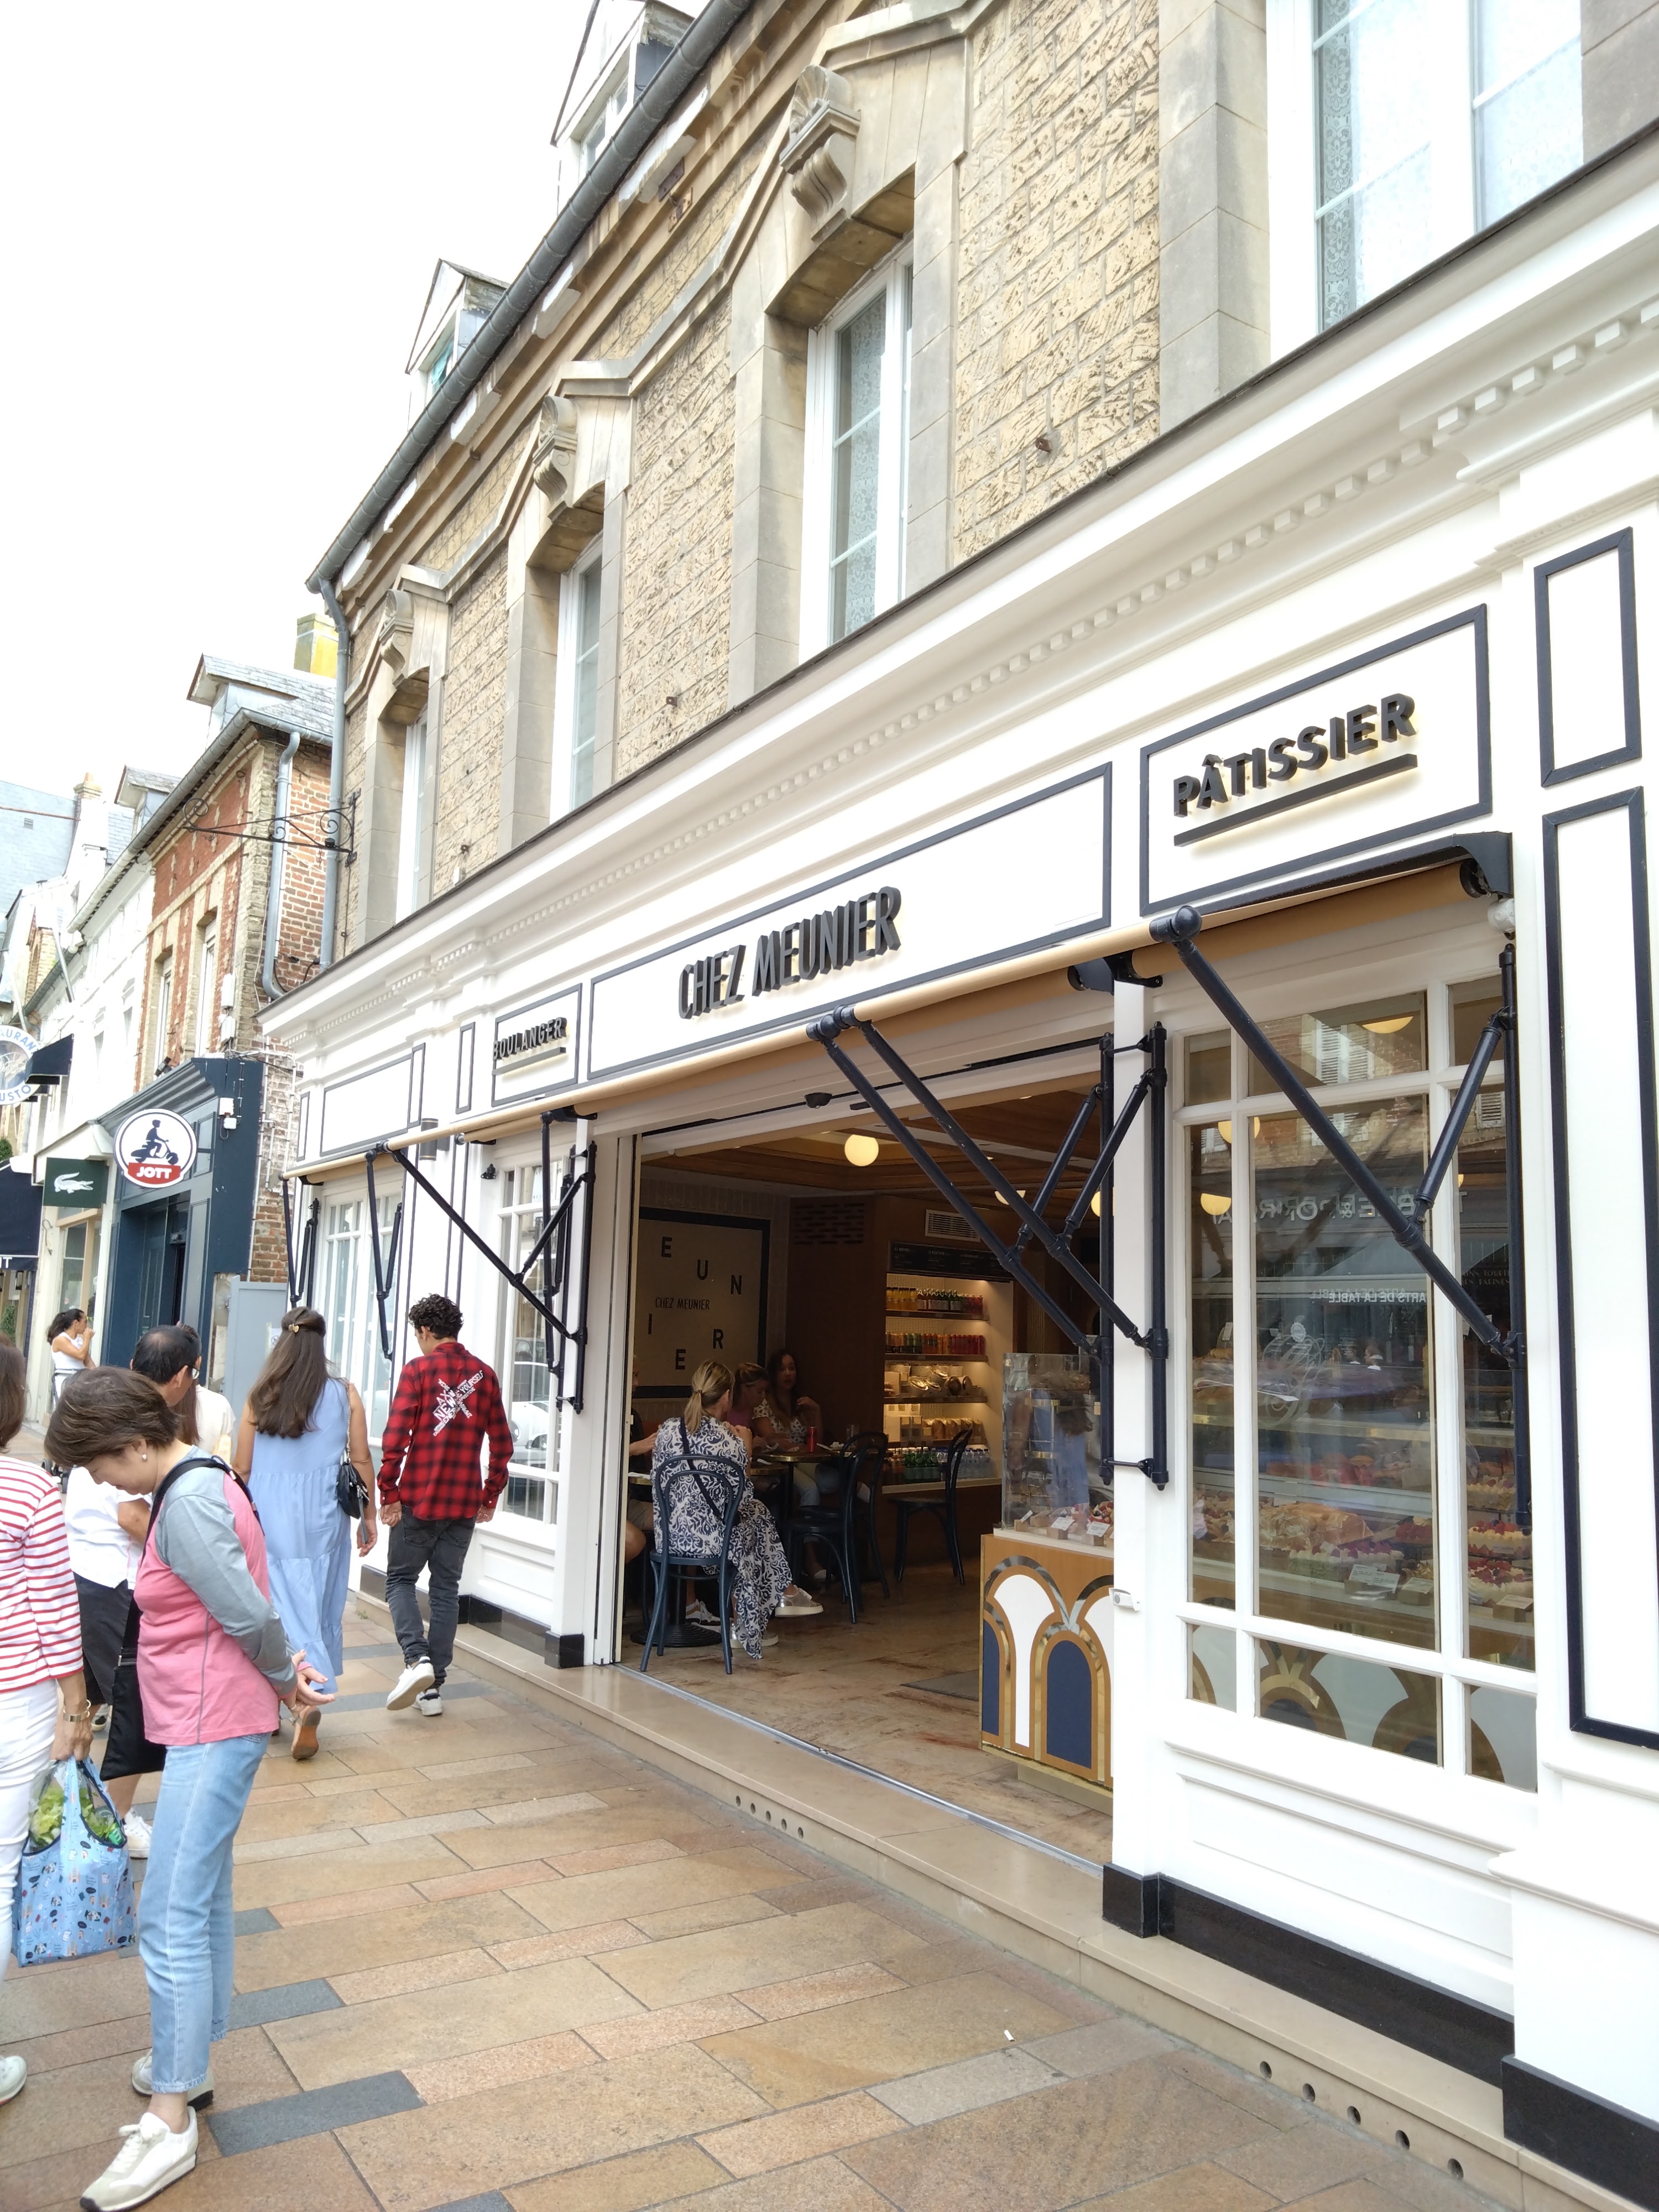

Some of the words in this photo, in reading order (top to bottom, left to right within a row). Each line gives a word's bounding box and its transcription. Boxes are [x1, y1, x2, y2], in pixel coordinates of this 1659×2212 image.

[1173, 692, 1417, 817] PÂTISSIER
[678, 945, 747, 1020] CHEZ
[752, 886, 901, 997] MEUNIER
[0, 1029, 39, 1054] AURAN
[493, 1017, 567, 1061] BOULANGER
[137, 1166, 172, 1179] JOTT
[661, 1237, 673, 1258] E
[697, 1260, 709, 1280] U
[730, 1275, 742, 1295] N
[655, 1297, 674, 1308] CHEZ
[676, 1298, 710, 1310] MEUNIER
[712, 1329, 724, 1349] R
[675, 1349, 686, 1370] E
[434, 1397, 456, 1421] NEW
